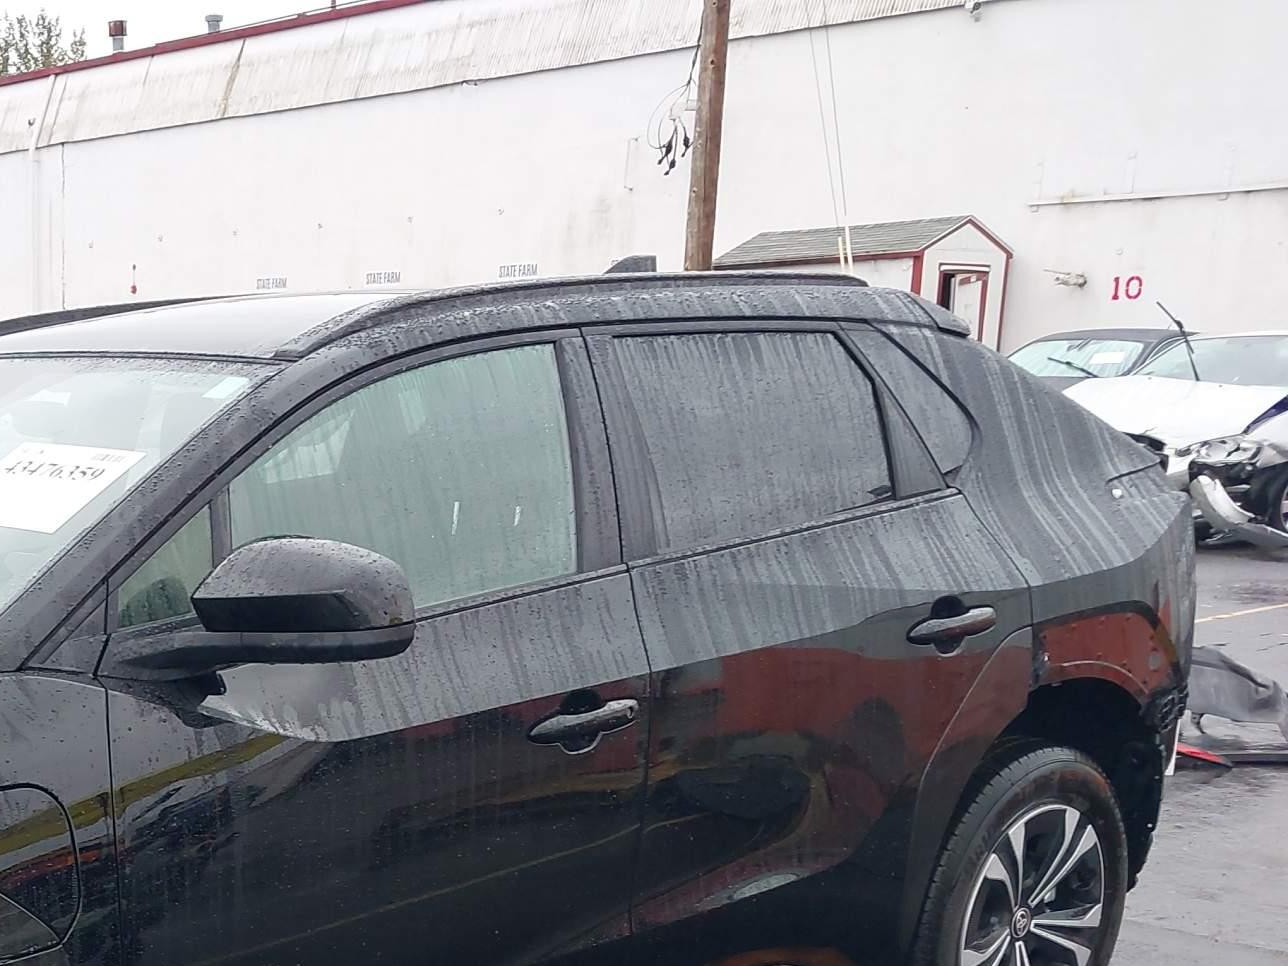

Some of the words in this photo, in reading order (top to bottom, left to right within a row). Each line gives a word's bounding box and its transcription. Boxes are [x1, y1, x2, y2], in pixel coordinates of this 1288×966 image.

[365, 272, 383, 285] STATE
[383, 271, 401, 284] FARM
[498, 264, 517, 278] STATE
[518, 263, 538, 277] FARM
[1110, 275, 1144, 301] 10
[3, 460, 107, 481] 43476359
